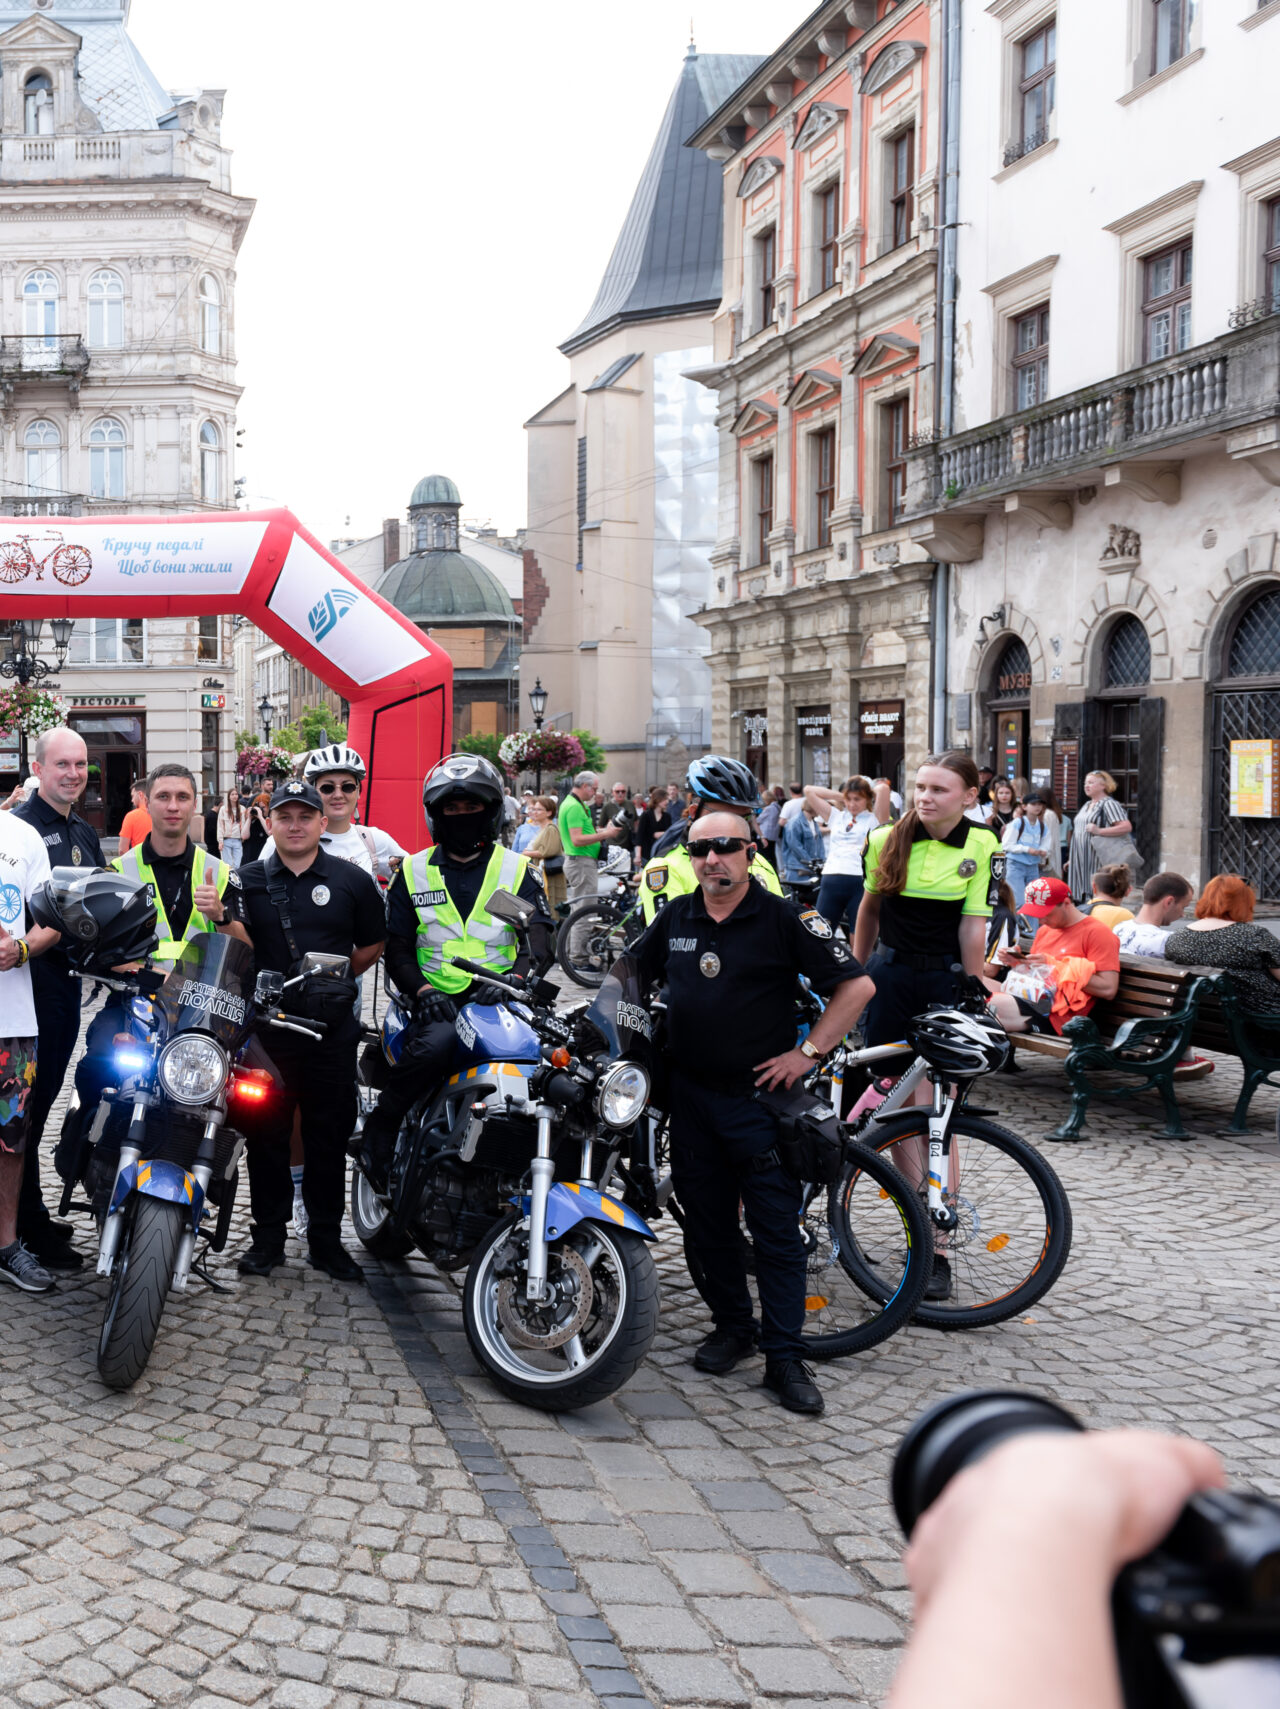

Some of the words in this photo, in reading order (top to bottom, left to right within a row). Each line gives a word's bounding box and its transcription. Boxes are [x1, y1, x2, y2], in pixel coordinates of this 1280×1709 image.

[102, 537, 152, 557] Кручу
[156, 537, 205, 557] педалі
[117, 559, 152, 576] Щоб
[152, 559, 188, 574] вони
[189, 561, 233, 574] жили
[999, 672, 1032, 691] МУЗЕ
[73, 697, 137, 706] РЕСТОРАН
[42, 832, 63, 847] ЛІЦІЯ
[412, 891, 447, 907] ПОЛІЦІЯ
[183, 979, 247, 1011] ПАТРУЛЬНА
[177, 990, 246, 1026] ПОЛІЦІЯ
[931, 1130, 942, 1158] 004
